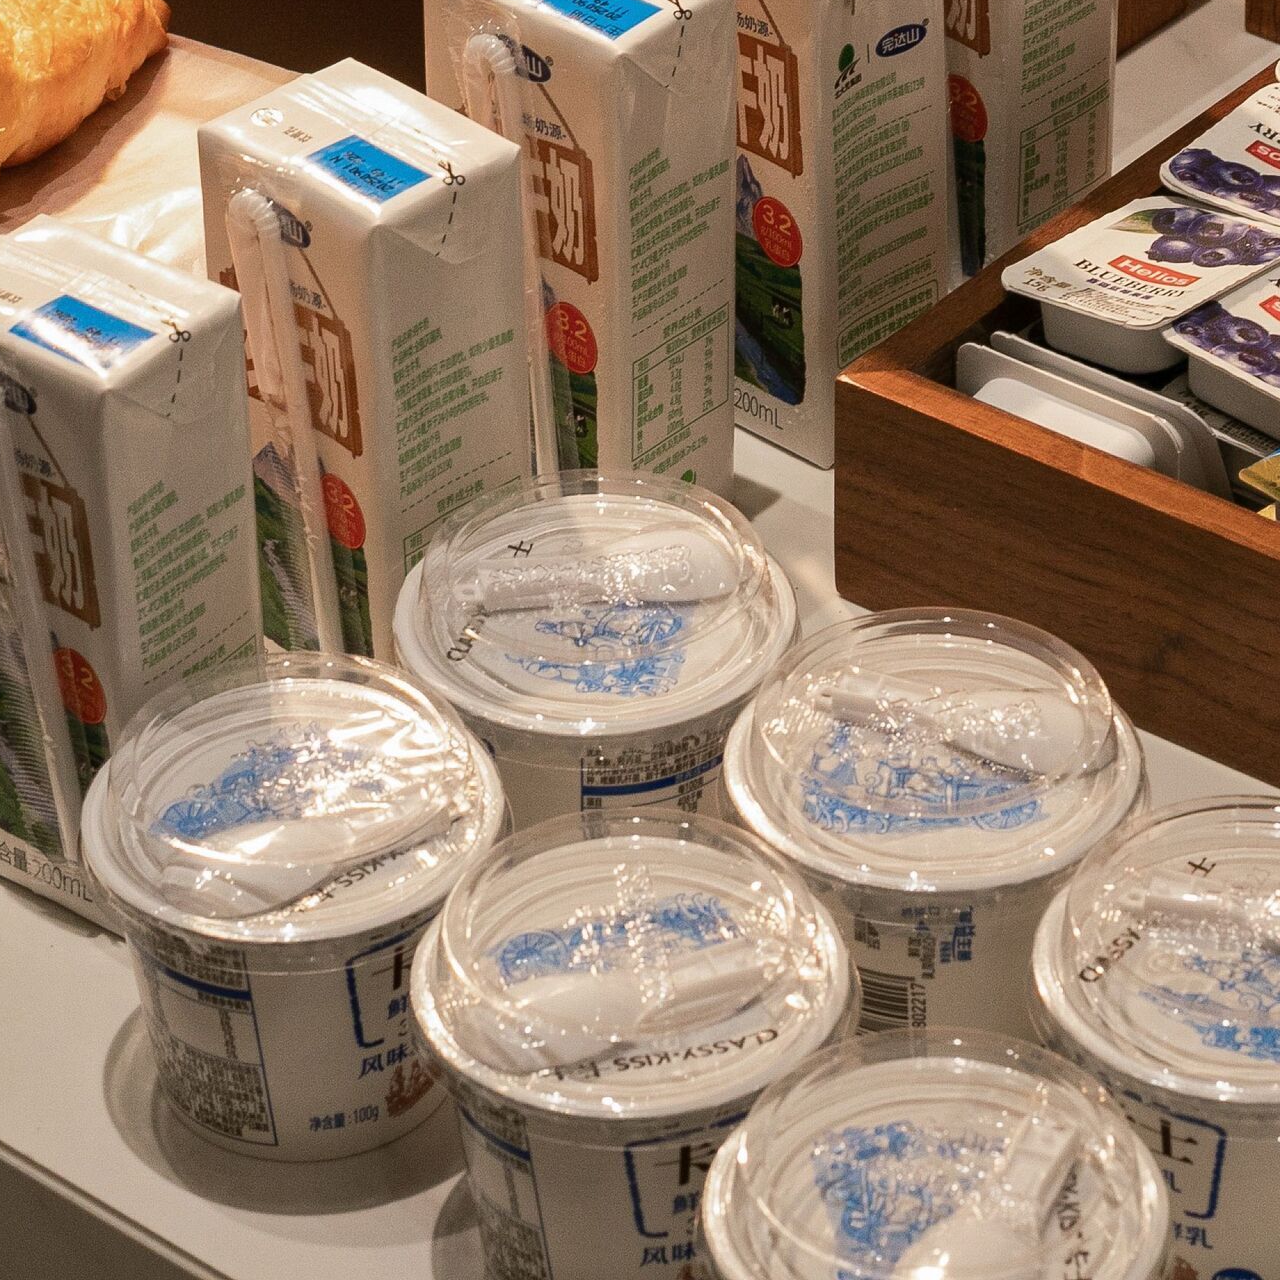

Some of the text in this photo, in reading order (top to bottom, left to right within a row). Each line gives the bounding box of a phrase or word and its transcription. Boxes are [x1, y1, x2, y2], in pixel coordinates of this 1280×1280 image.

[881, 27, 920, 54] 完达山
[762, 204, 791, 236] 3.2
[1072, 258, 1193, 298] BLUEBERRY
[1116, 258, 1191, 287] Helios
[733, 387, 784, 430] 200mL
